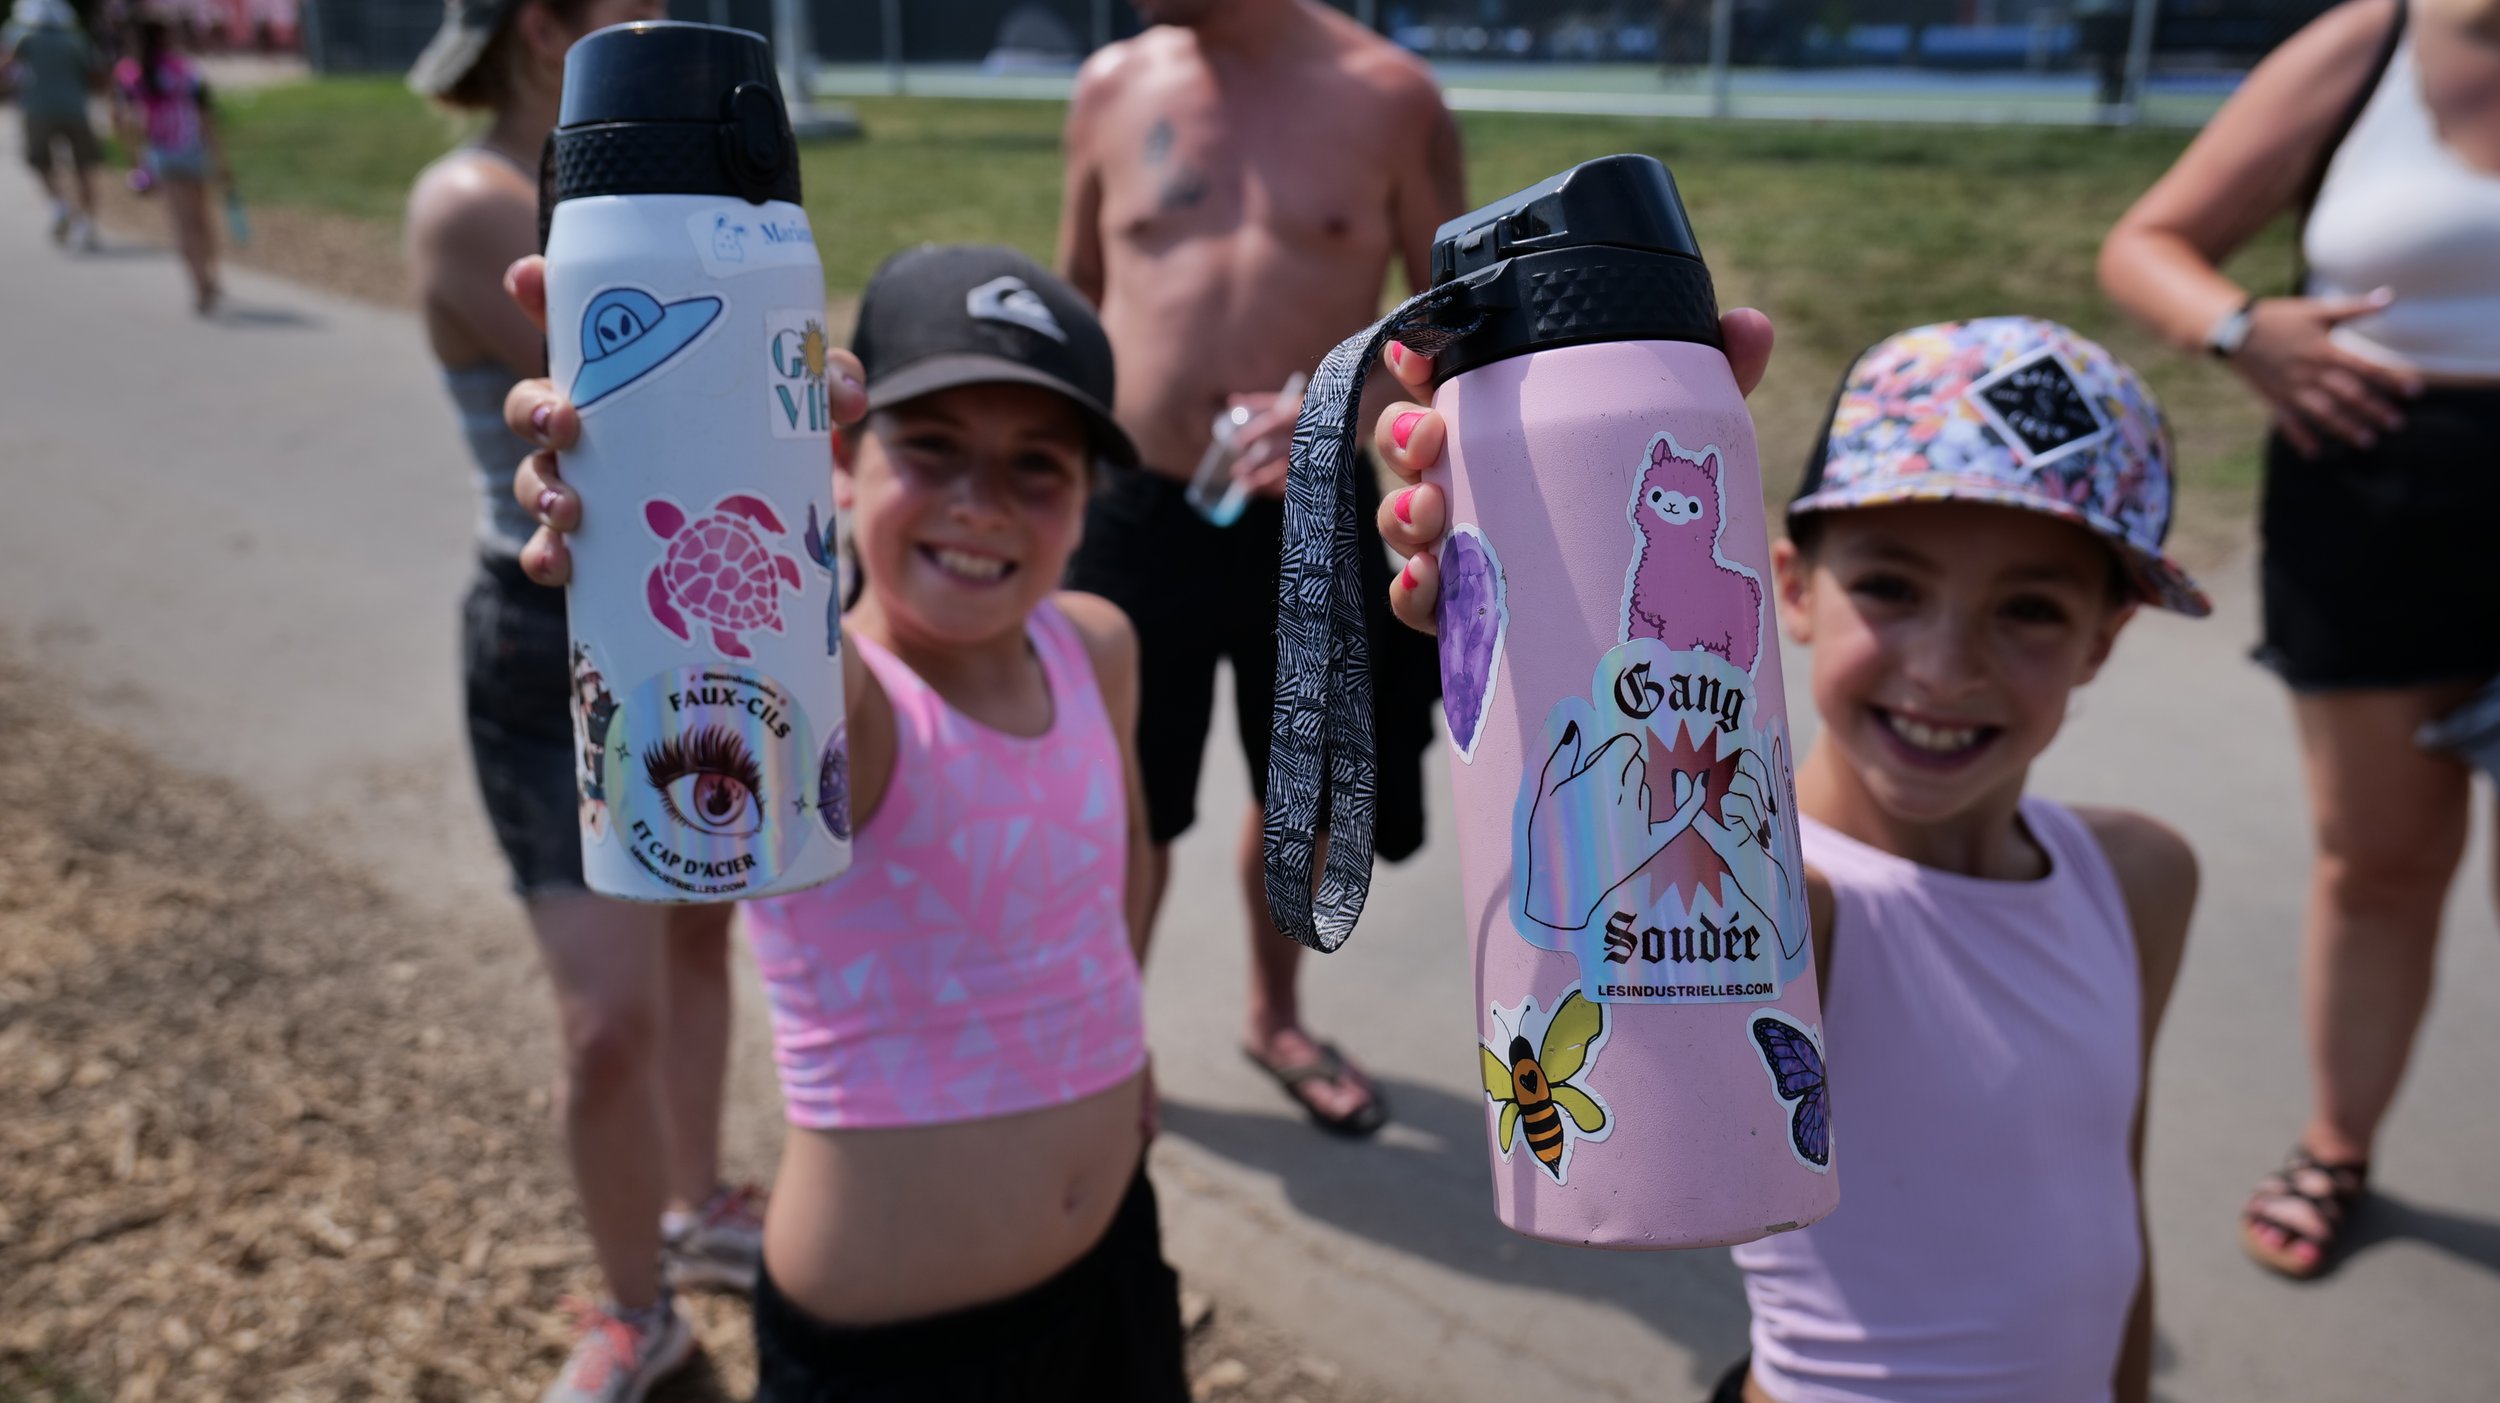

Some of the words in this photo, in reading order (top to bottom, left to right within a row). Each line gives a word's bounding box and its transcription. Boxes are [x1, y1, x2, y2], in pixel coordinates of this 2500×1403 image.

[668, 687, 791, 738] FAUX-CILS
[1613, 660, 1746, 733] Gang
[631, 819, 654, 841] ET
[648, 841, 683, 868] CAP
[683, 852, 757, 879] D'ACIER
[1602, 910, 1762, 965] Soudée
[1597, 983, 1774, 999] LESINDUSTRIELLES.COM
